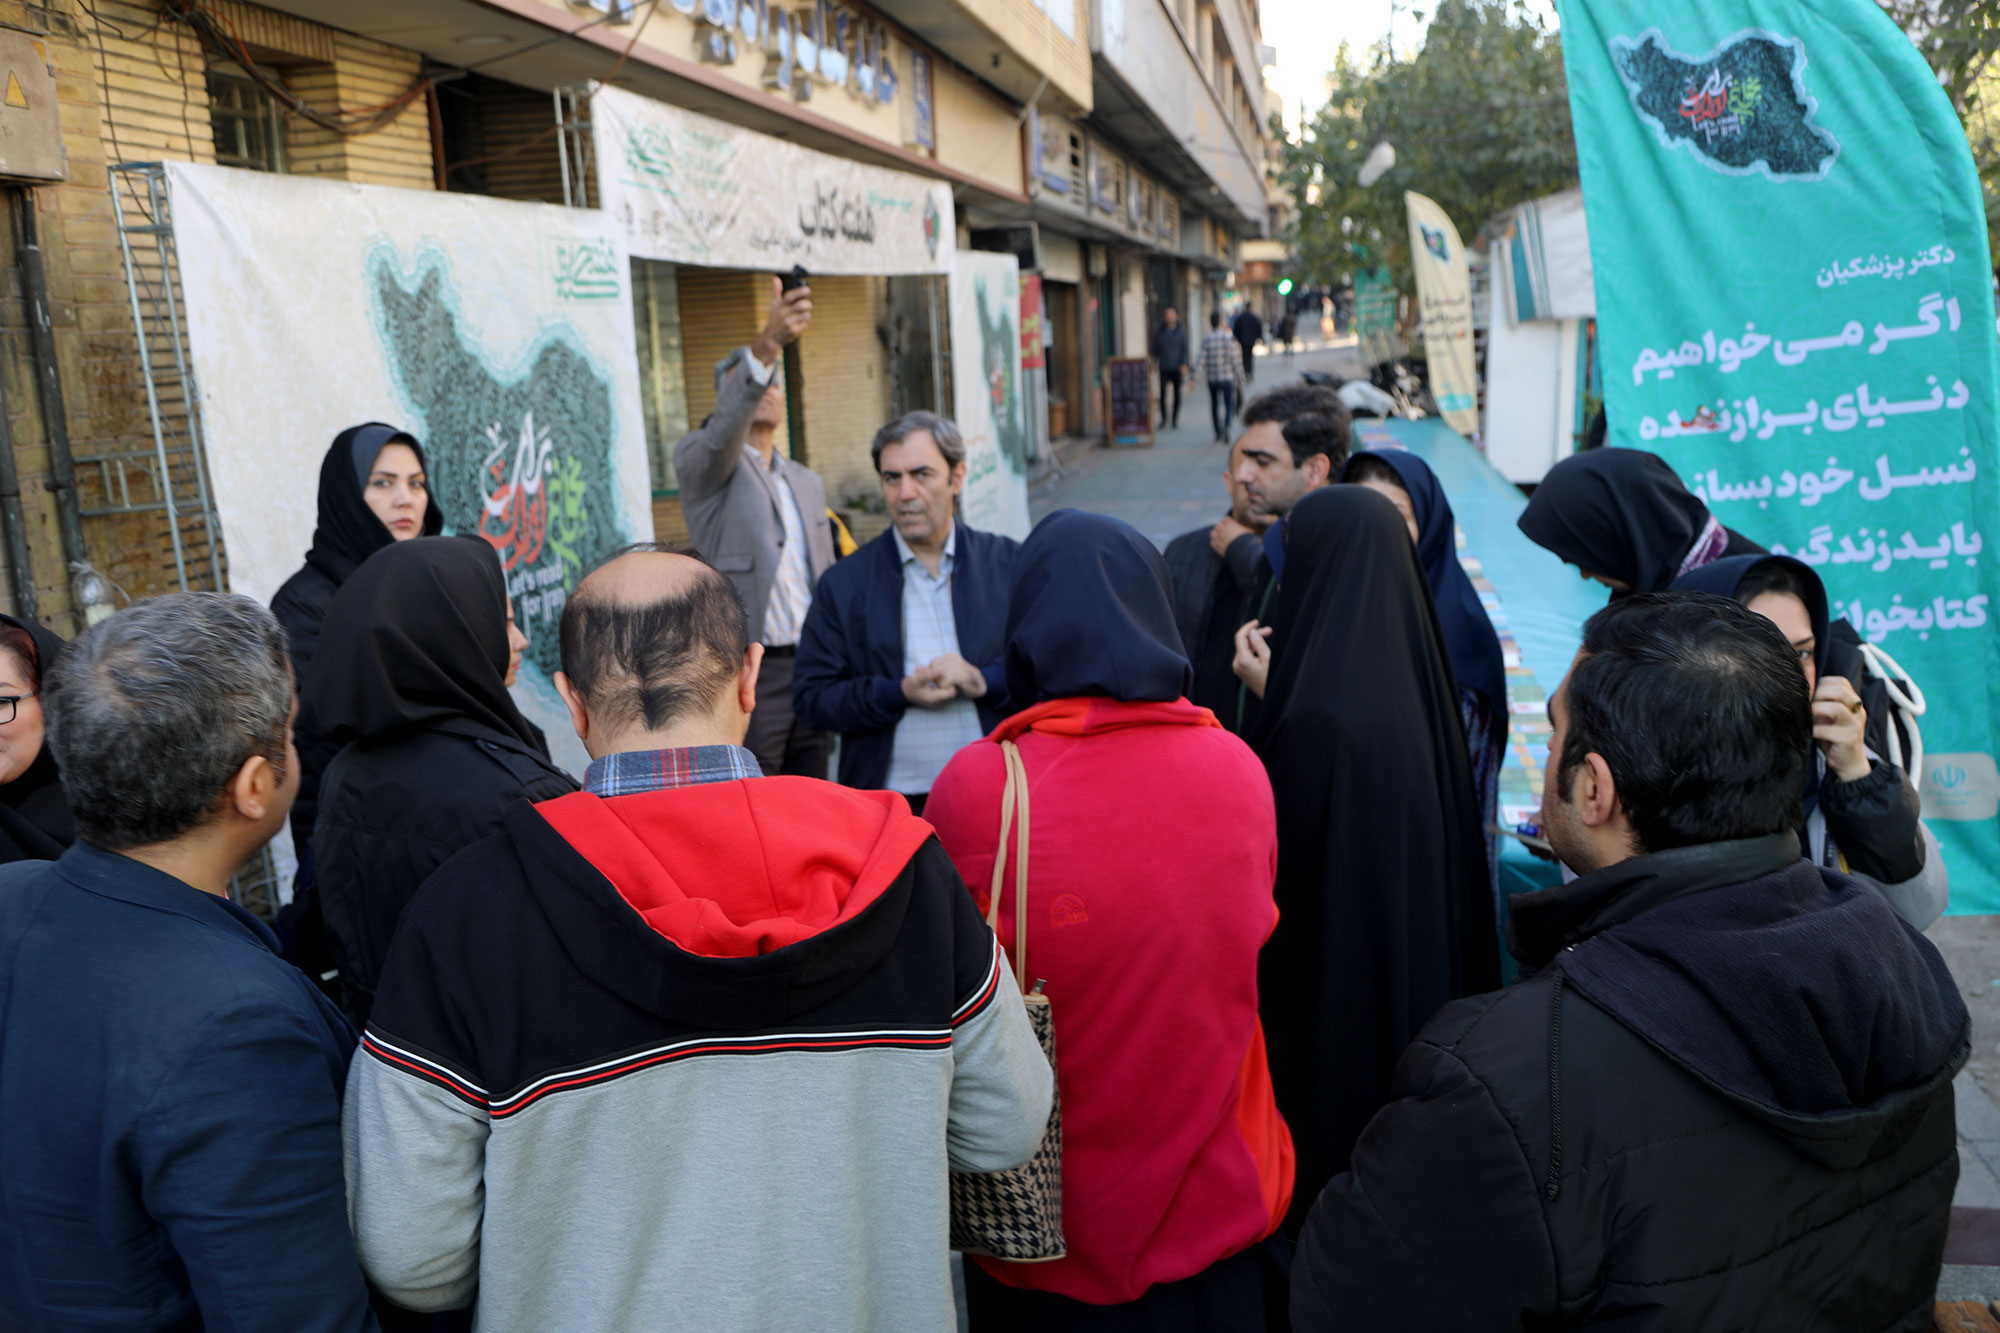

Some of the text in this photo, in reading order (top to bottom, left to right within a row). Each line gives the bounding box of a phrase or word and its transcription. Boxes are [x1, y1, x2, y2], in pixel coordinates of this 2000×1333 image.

[1816, 244, 1956, 288] دکتر پزشکیان
[1869, 292, 1961, 355] اگر
[1639, 376, 1970, 442] دنیای برازنده
[1775, 457, 1854, 507] خود
[1858, 447, 1977, 501] نسل
[1893, 521, 1982, 569] باید
